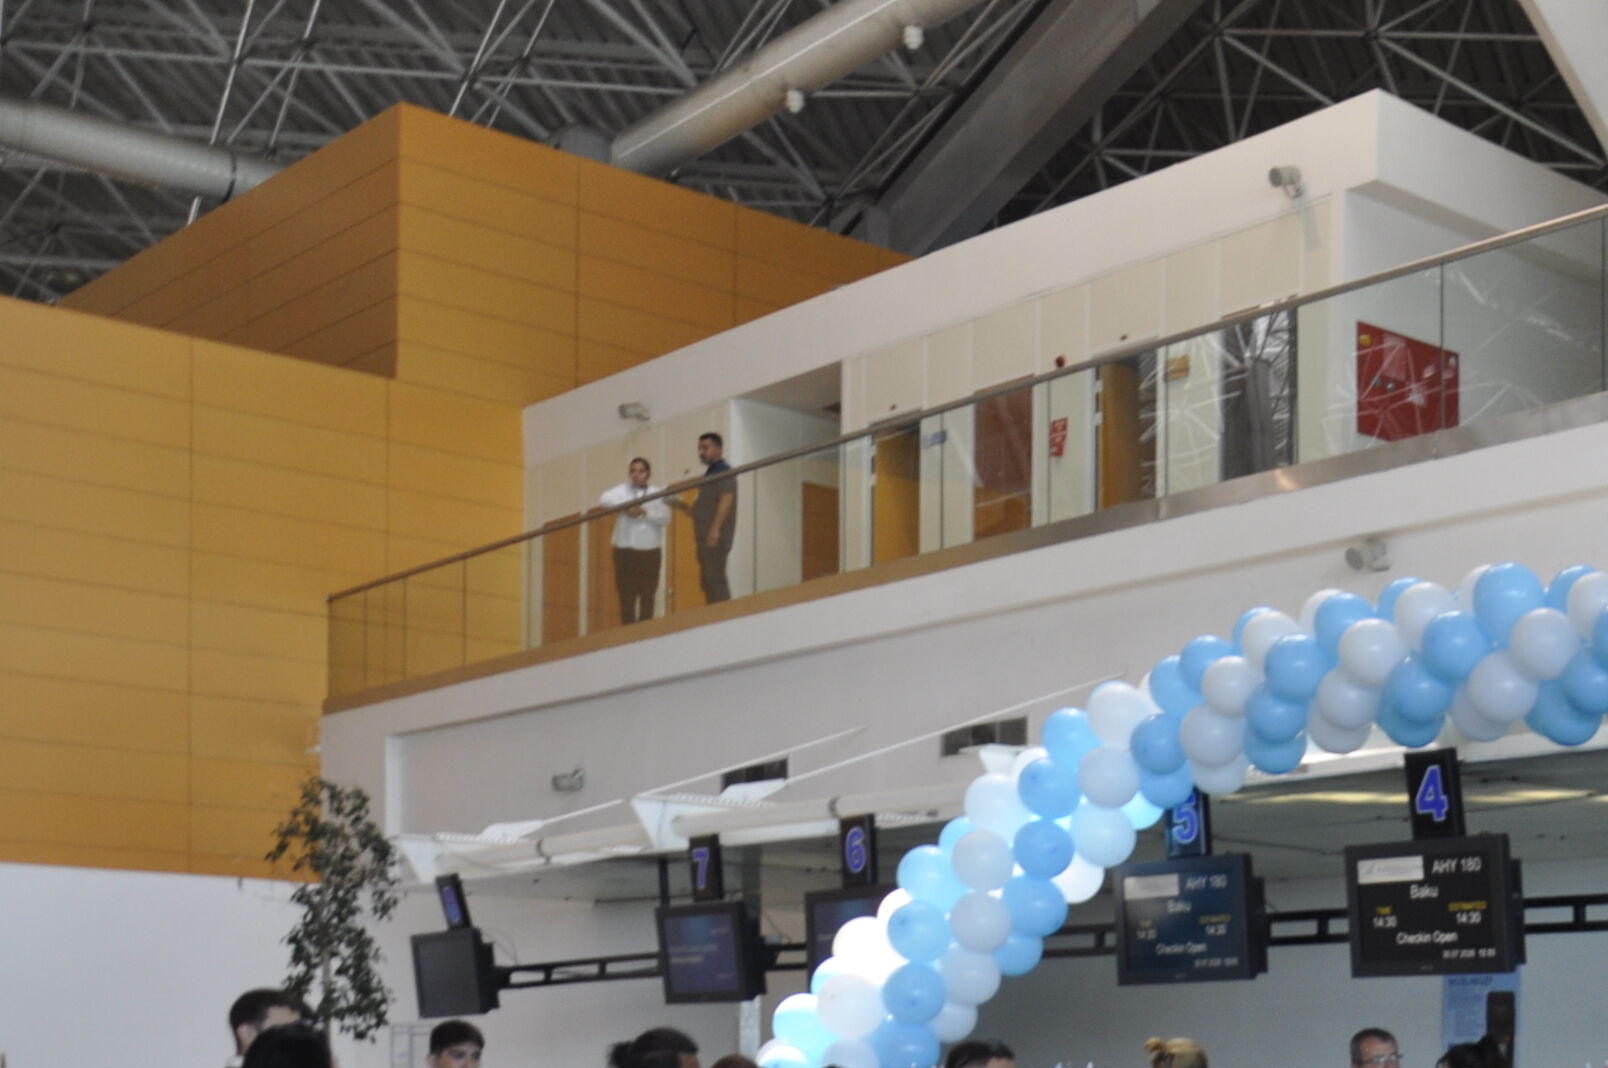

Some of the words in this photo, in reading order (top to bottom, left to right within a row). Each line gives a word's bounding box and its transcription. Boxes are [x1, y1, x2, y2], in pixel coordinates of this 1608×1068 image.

[1415, 764, 1448, 822] 4
[1172, 791, 1198, 844] 5
[692, 847, 710, 890] 7
[845, 826, 866, 873] 6
[1432, 859, 1457, 873] AHY
[1461, 857, 1481, 871] 180
[1411, 884, 1438, 898] Baku
